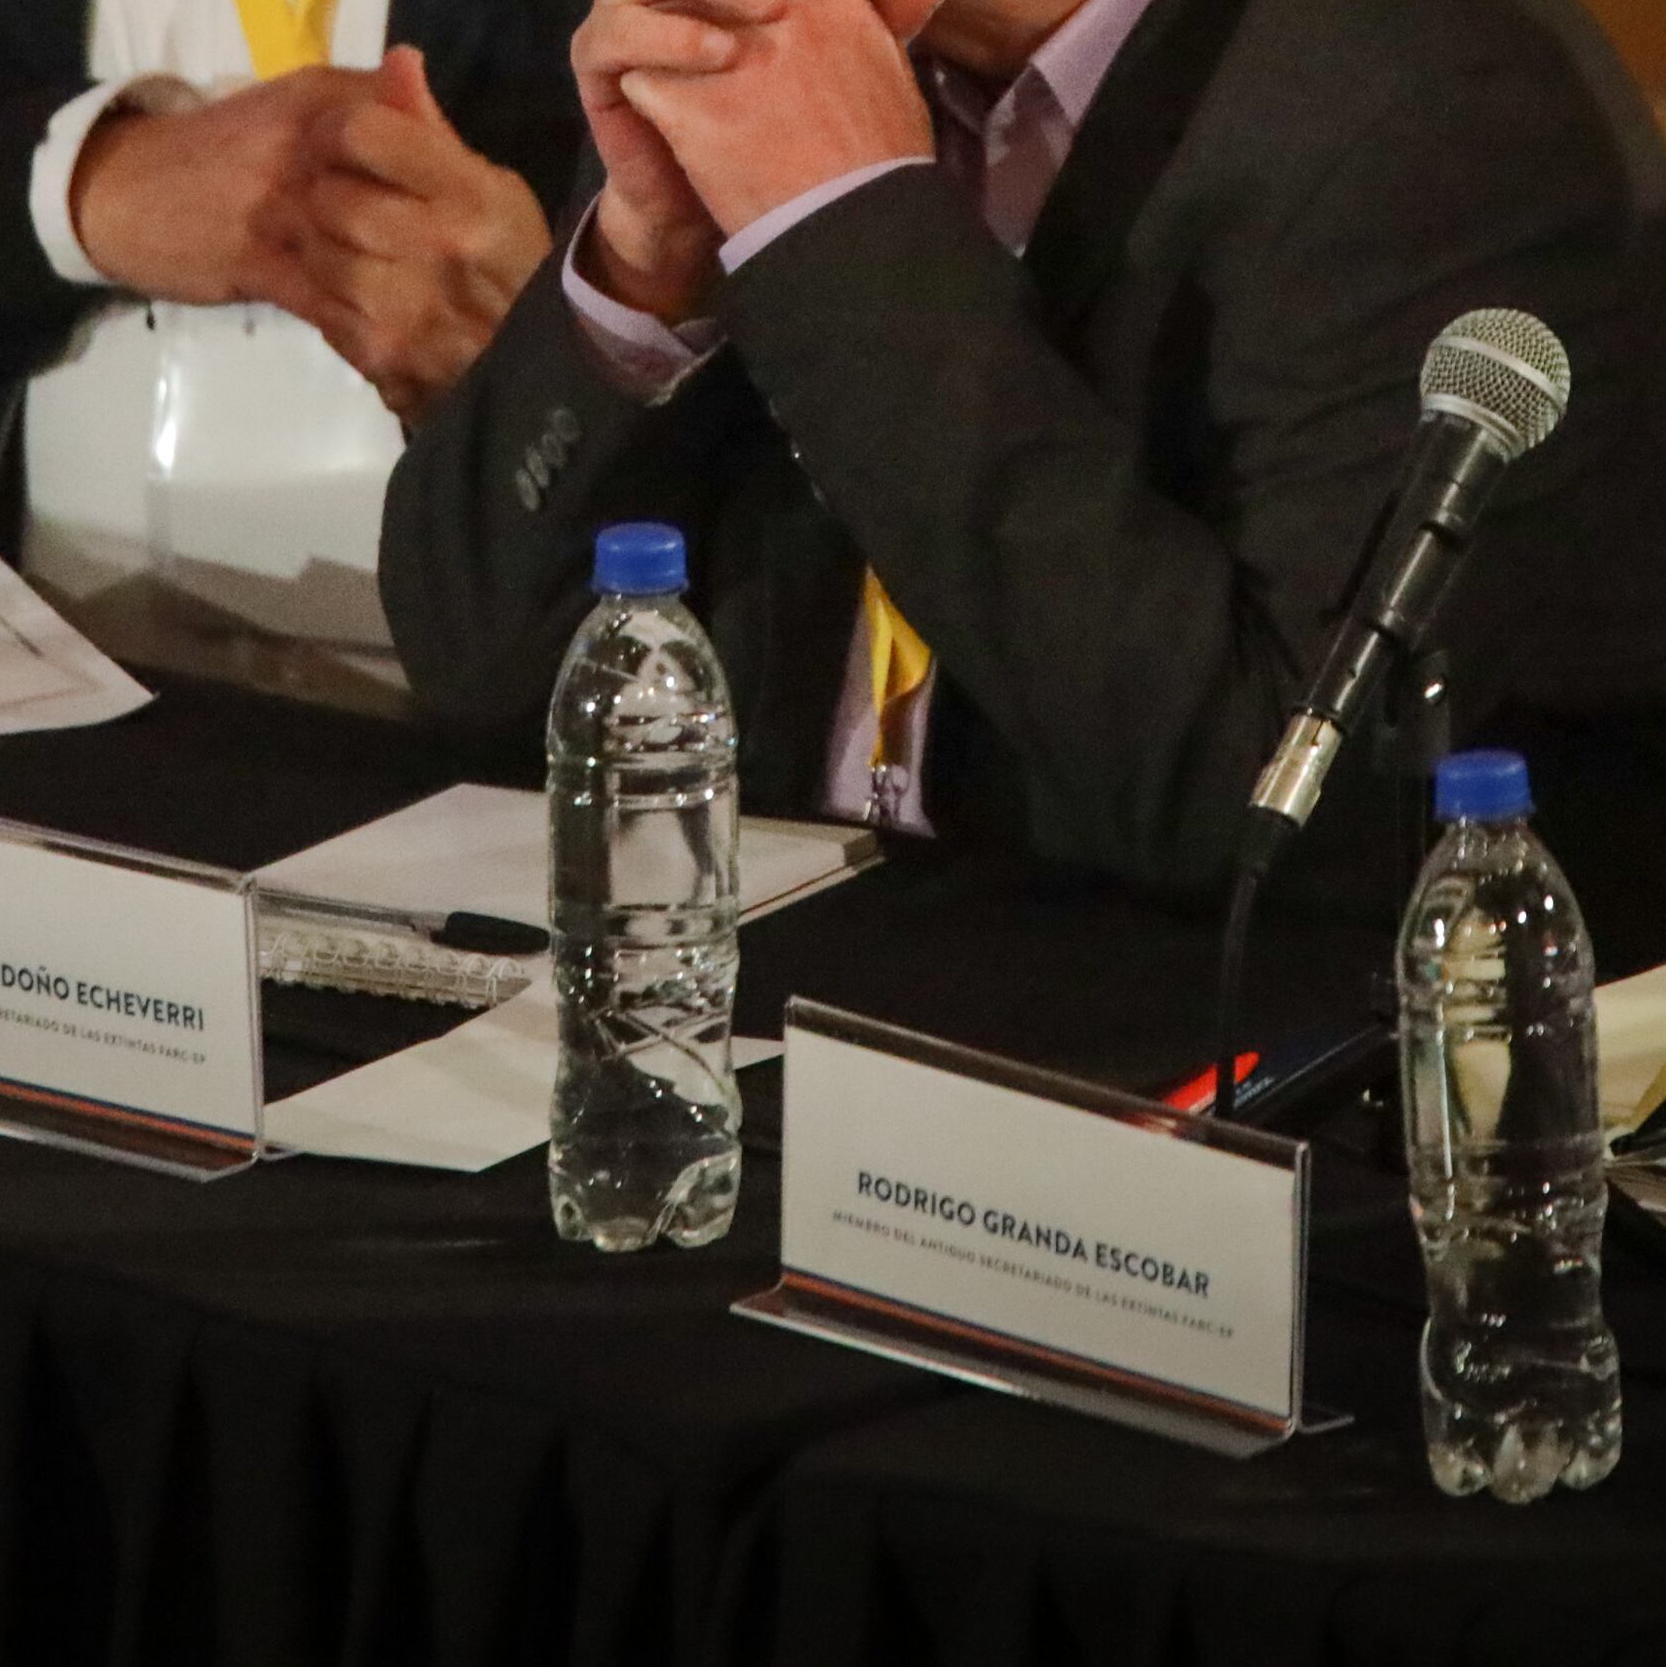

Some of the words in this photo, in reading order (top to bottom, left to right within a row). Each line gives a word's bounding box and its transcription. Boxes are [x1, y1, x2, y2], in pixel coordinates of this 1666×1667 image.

[63, 1023, 76, 1036] DE
[80, 1028, 101, 1042] LAS
[75, 982, 205, 1031] ECHEVERRI
[833, 1209, 890, 1236] MIEMBRO
[894, 1228, 916, 1244] DEL
[921, 1238, 976, 1262] ANTIGUO
[980, 1253, 1071, 1293] SECRETARIADO
[1076, 1283, 1090, 1297] DE
[857, 1171, 977, 1226] RODRIGO
[981, 1210, 1089, 1261] GRANDA
[1094, 1242, 1210, 1298] ESCOBAR
